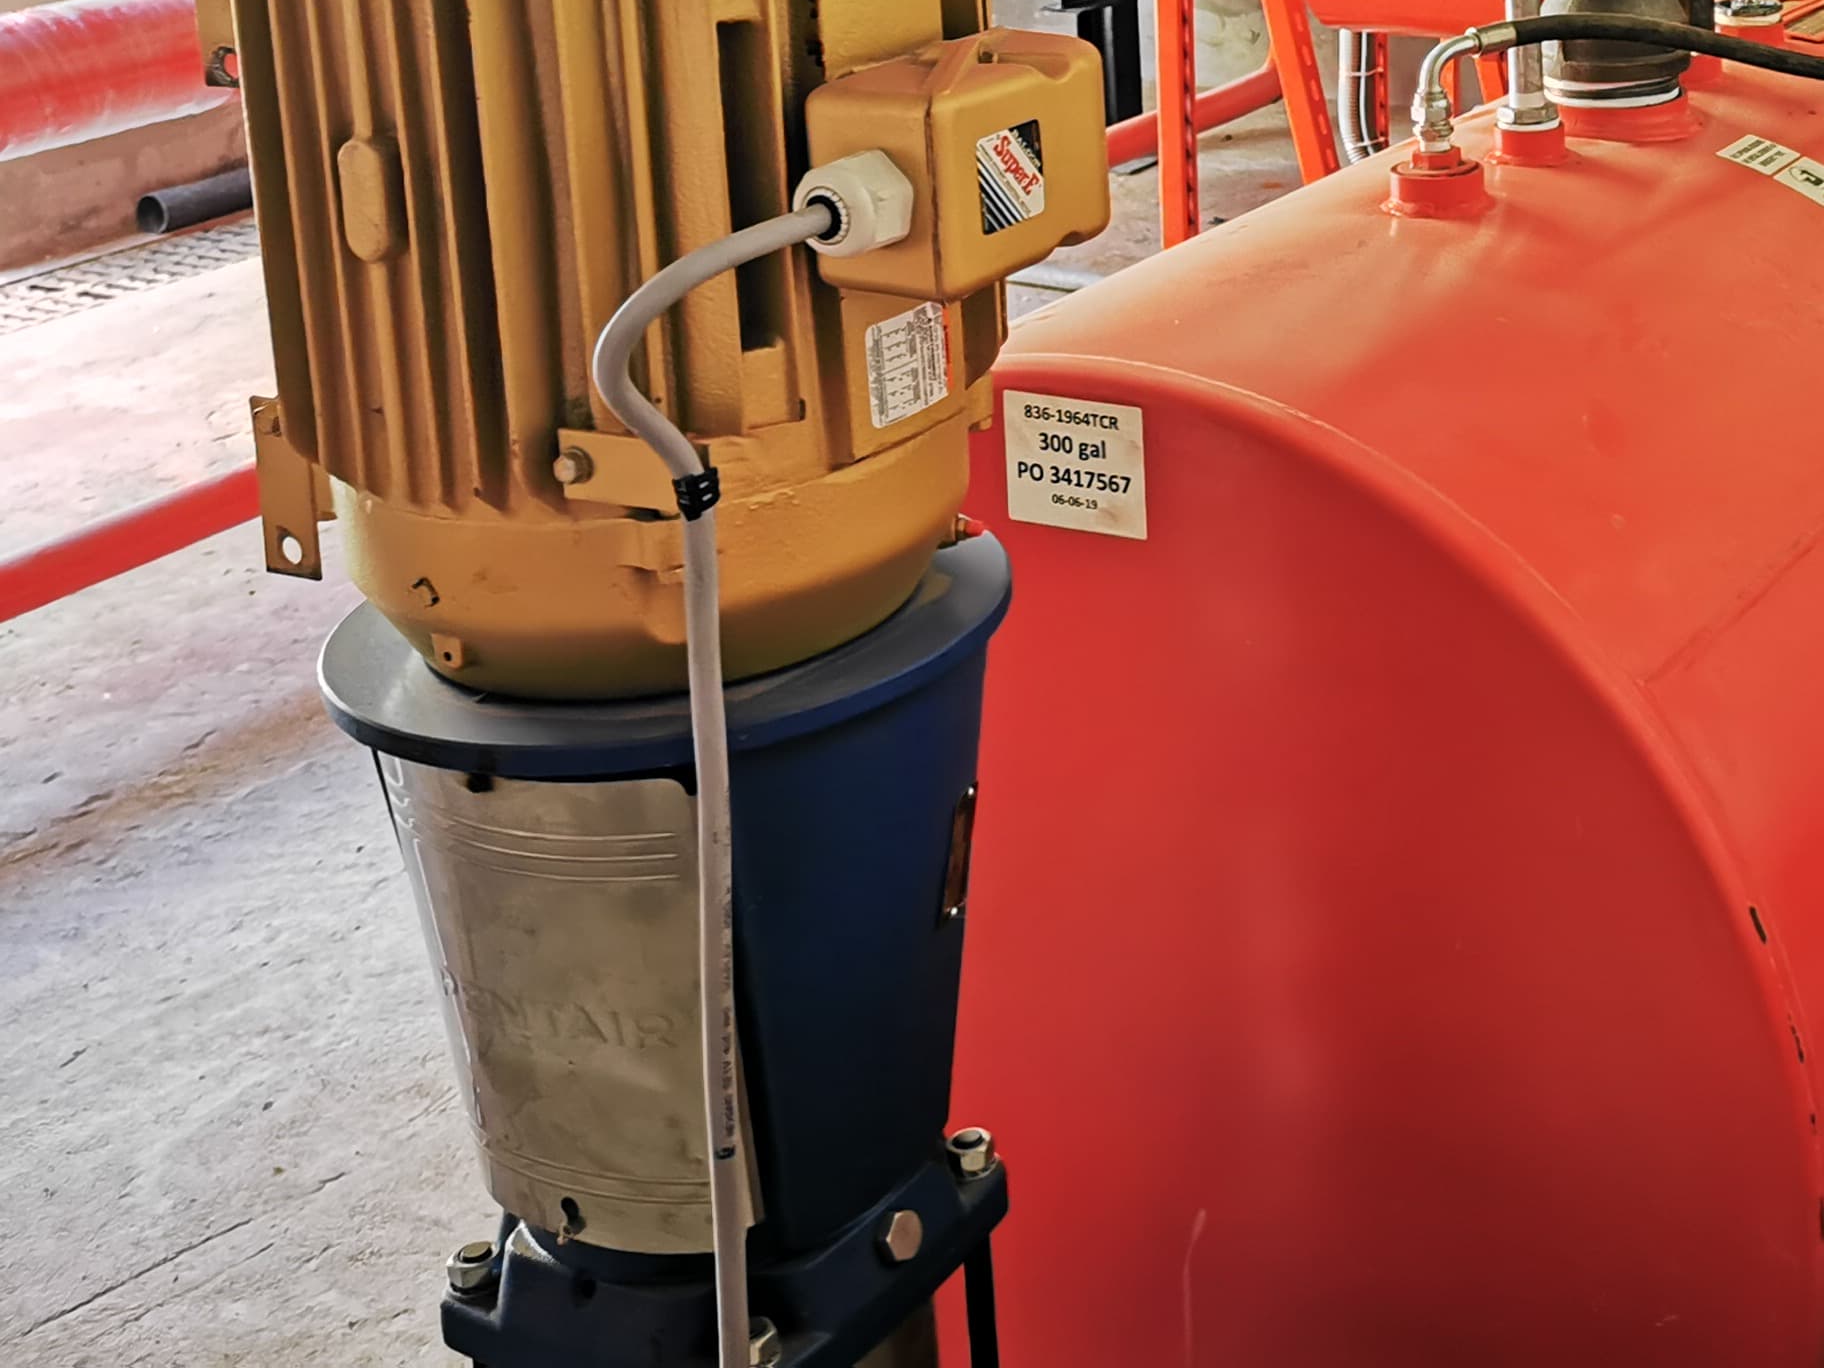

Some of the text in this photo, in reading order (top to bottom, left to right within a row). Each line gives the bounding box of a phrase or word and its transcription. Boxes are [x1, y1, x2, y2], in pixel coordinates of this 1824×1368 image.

[1023, 404, 1119, 430] 836-1964TCR
[1038, 432, 1106, 461] 300 gal
[1017, 461, 1131, 493] PO 3417567
